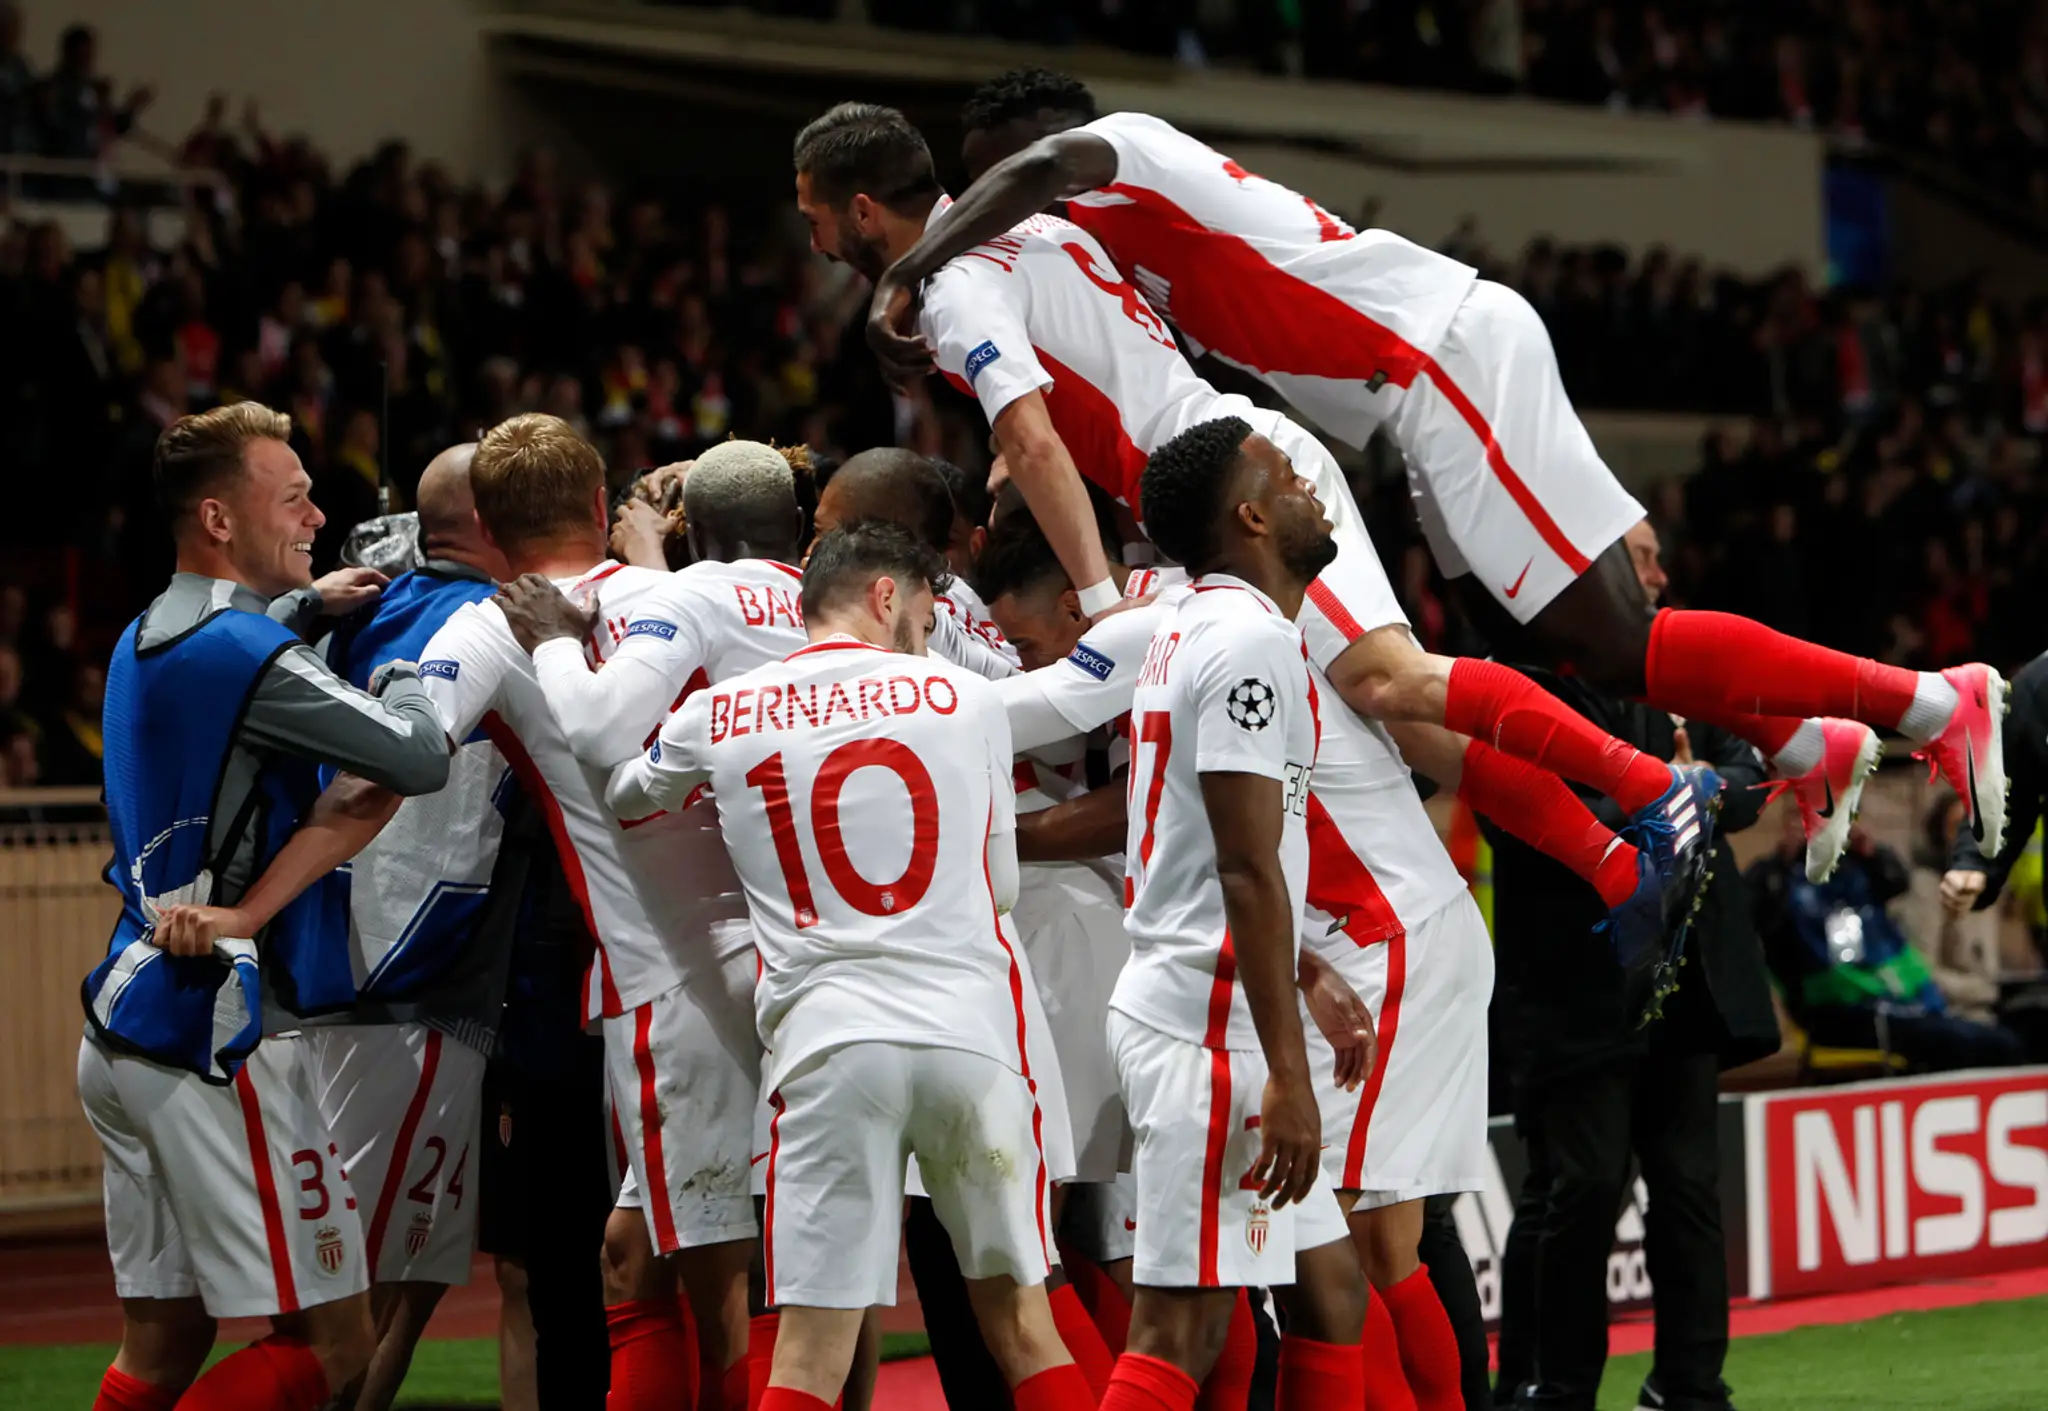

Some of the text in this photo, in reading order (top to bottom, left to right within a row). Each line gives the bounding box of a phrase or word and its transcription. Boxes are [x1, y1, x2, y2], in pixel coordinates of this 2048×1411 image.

[711, 675, 959, 745] BERNARDO
[745, 737, 940, 930] 10
[407, 1135, 470, 1211] 24
[1793, 1089, 2048, 1272] NISS
